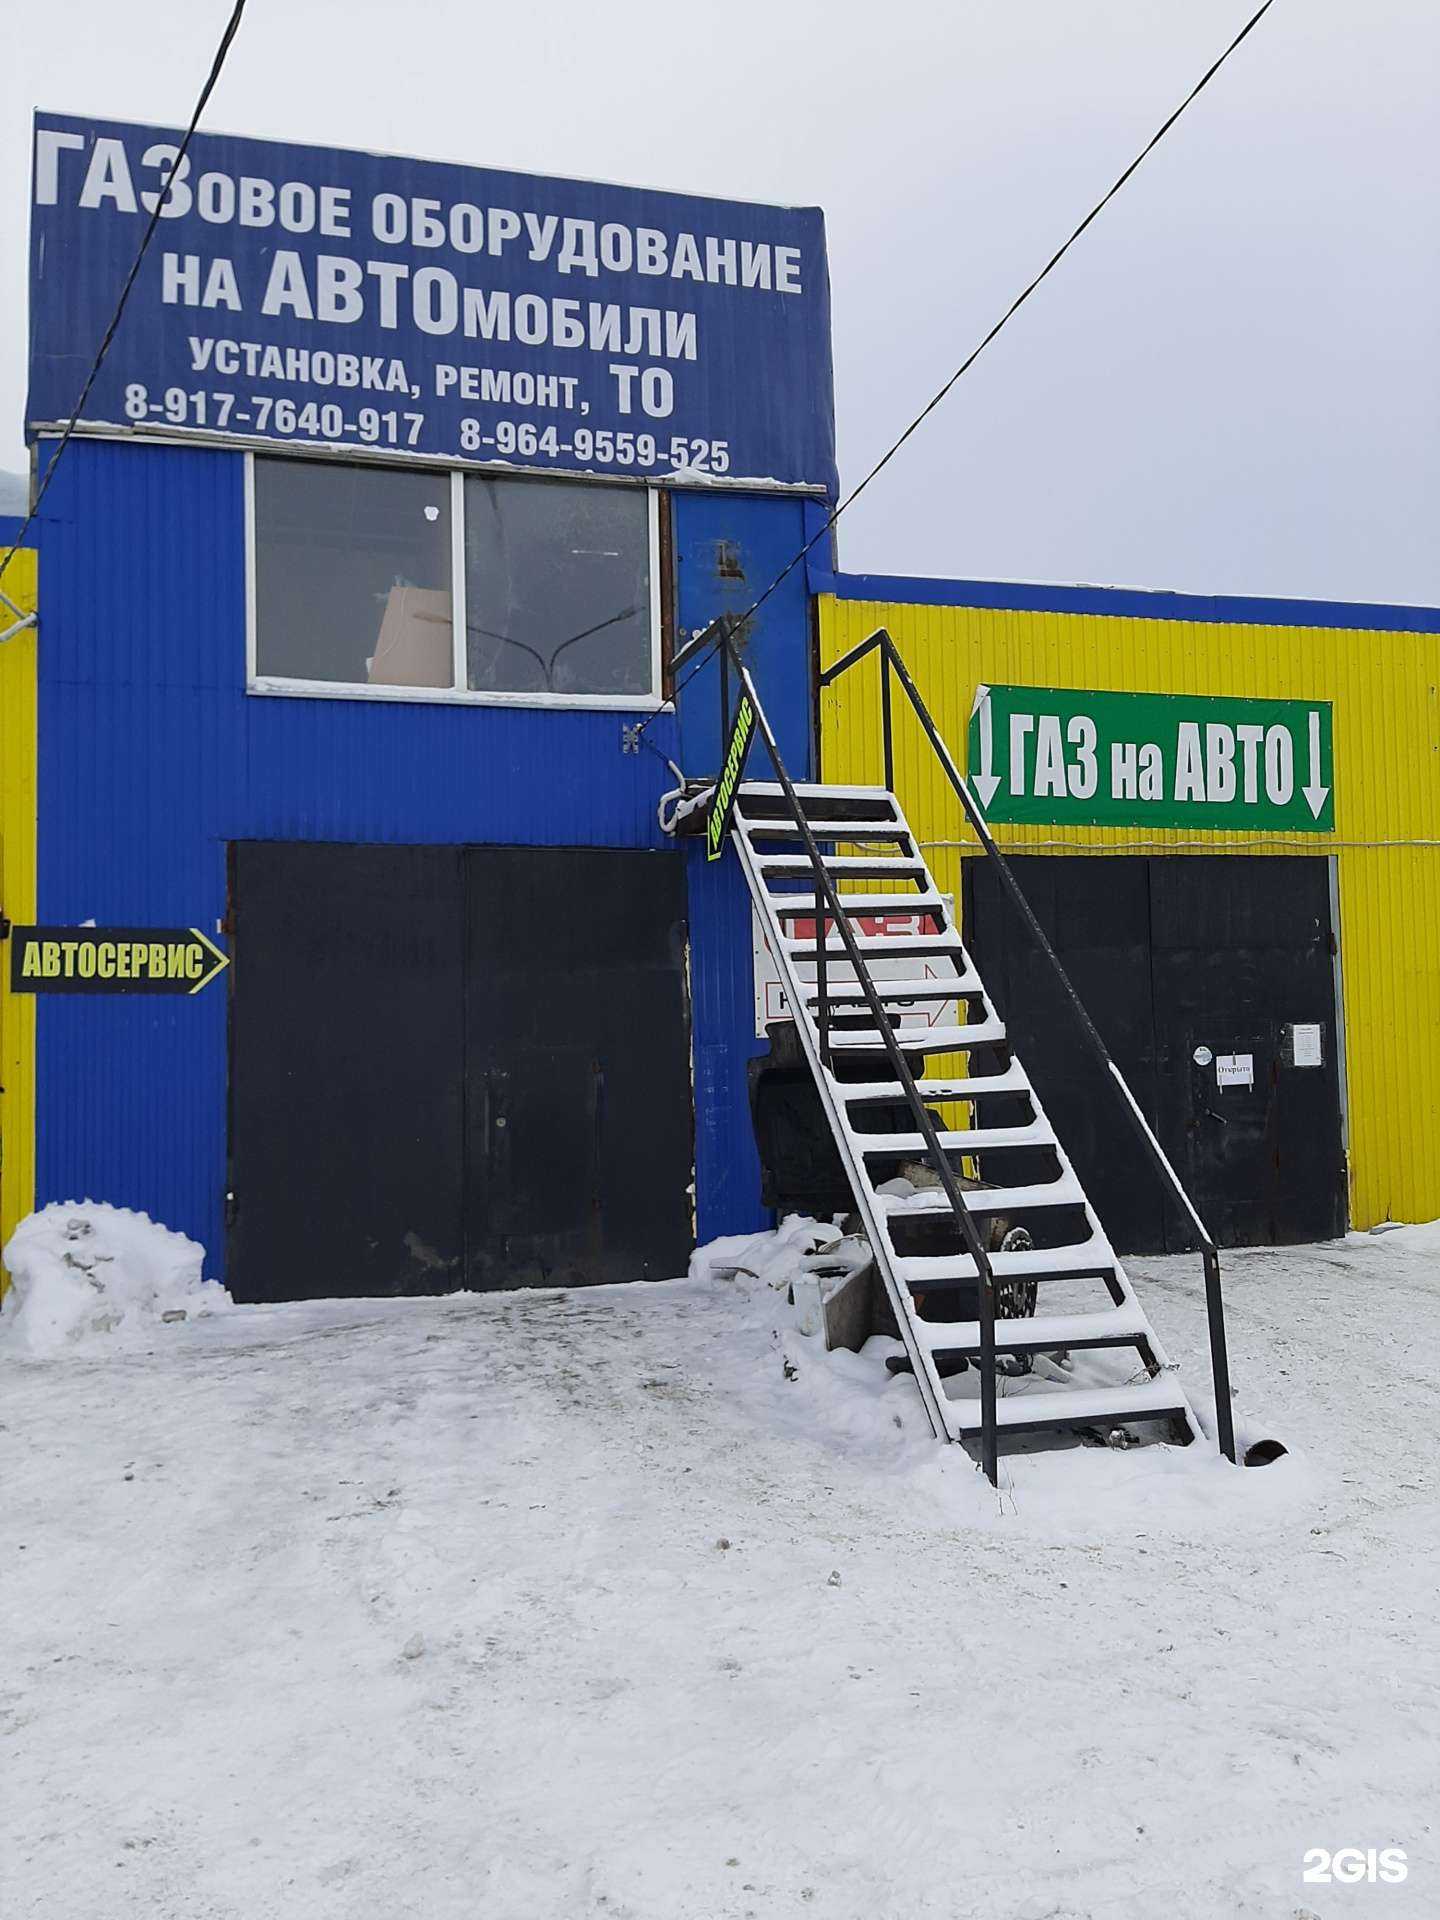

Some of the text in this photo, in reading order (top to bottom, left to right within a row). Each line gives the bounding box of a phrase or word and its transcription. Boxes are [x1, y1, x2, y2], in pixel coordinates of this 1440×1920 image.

[372, 193, 802, 294] ОБОРУДОВАНИЕ
[162, 249, 697, 361] НА АВТОМОБИЛИ
[188, 336, 674, 418] УСТАНОВКА, РЕМОНТ, ТО
[124, 383, 729, 473] 8-917-7640-917 8-964-9559-525
[711, 696, 753, 850] АВТОСЕРВИС
[1009, 713, 1294, 806] ГАЗ на АВТО
[22, 941, 204, 979] АВТОСЕРВИС
